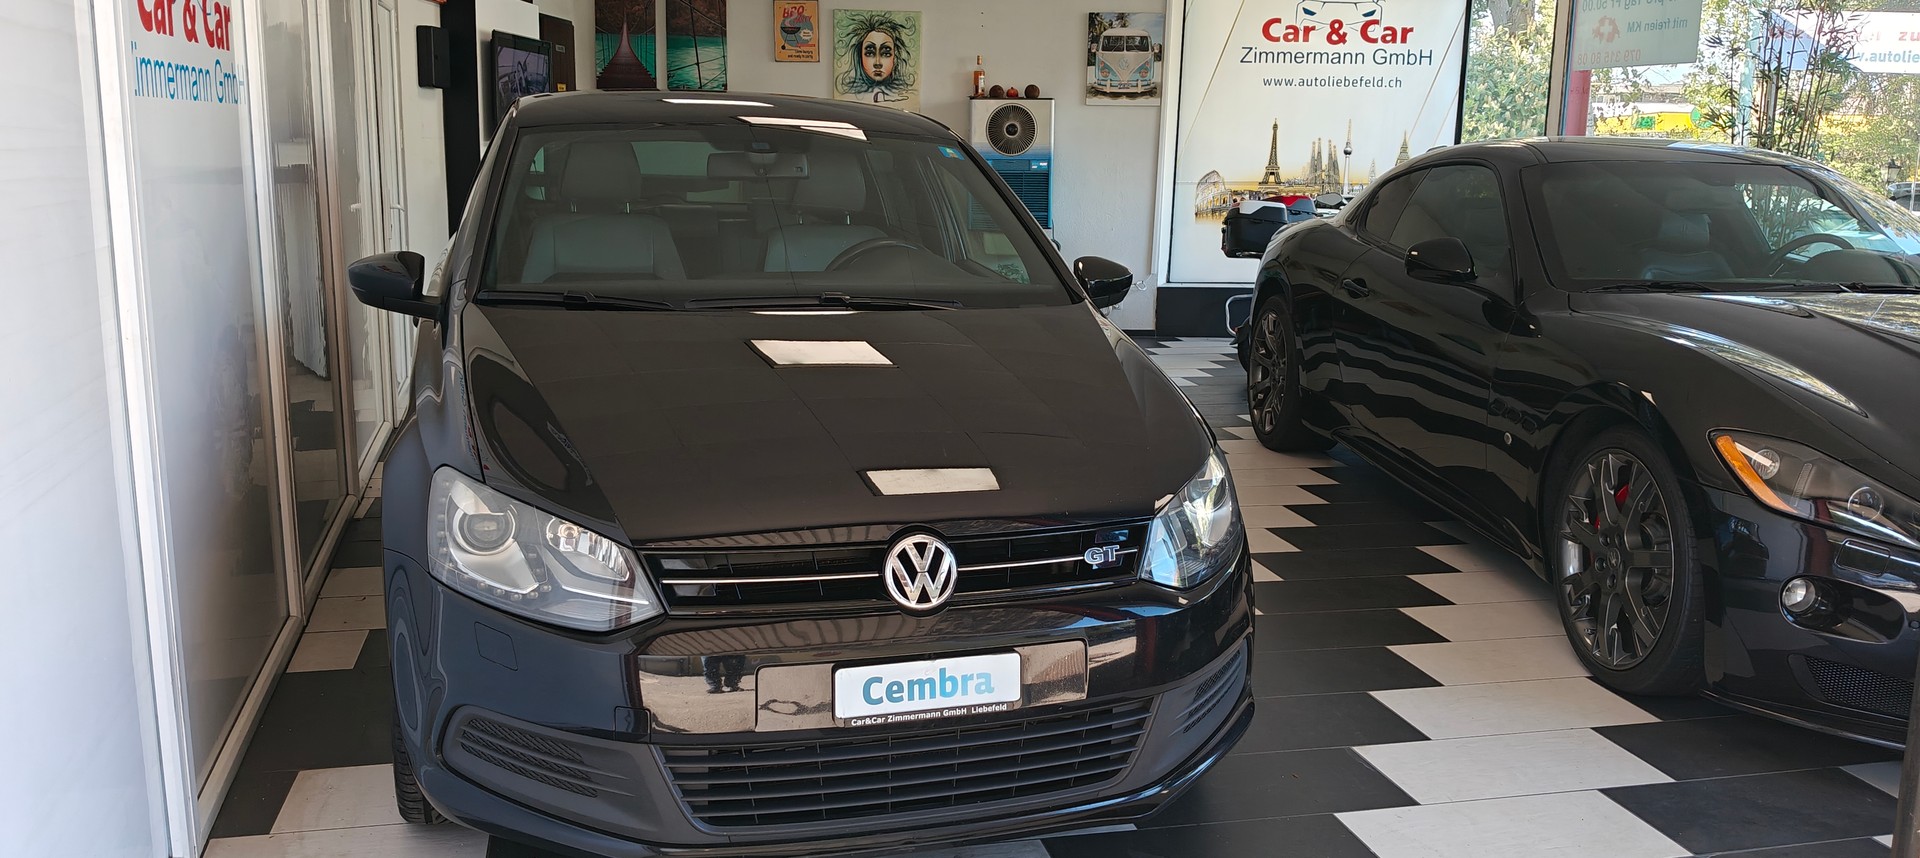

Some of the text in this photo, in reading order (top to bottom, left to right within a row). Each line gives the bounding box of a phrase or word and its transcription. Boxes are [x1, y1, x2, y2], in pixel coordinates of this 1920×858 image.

[1261, 18, 1414, 46] Car & Car
[1240, 46, 1433, 66] Zimmermann GmbH
[215, 59, 246, 104] GmbH
[1262, 76, 1402, 89] www.autoliebefeld.ch
[1084, 545, 1120, 565] GT
[886, 534, 957, 608] VW
[862, 667, 995, 706] Cembra
[851, 703, 1007, 727] Car&Car Zimmermann GmbH Liebefeld
